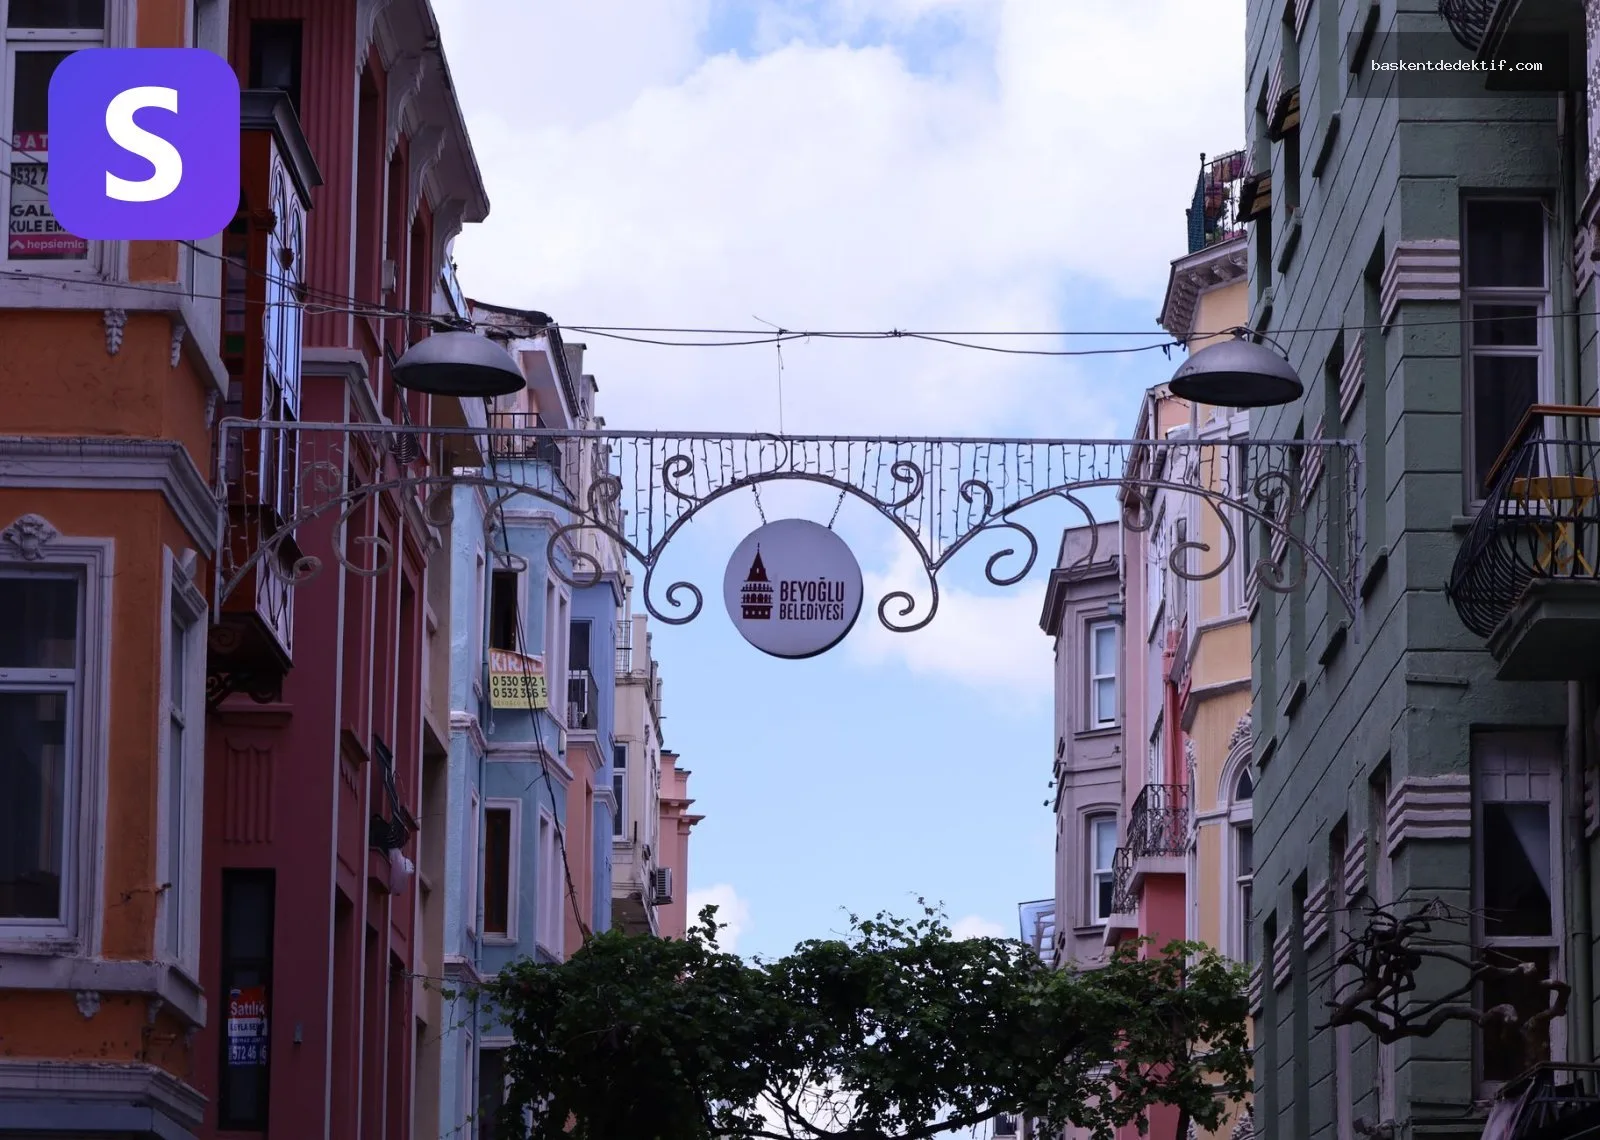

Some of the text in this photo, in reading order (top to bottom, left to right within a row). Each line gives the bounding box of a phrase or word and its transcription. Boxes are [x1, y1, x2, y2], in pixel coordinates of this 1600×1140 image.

[780, 577, 844, 602] BEYOĞLU
[780, 603, 844, 620] BELEDİYESİ
[501, 676, 518, 686] 530
[501, 688, 518, 698] 532
